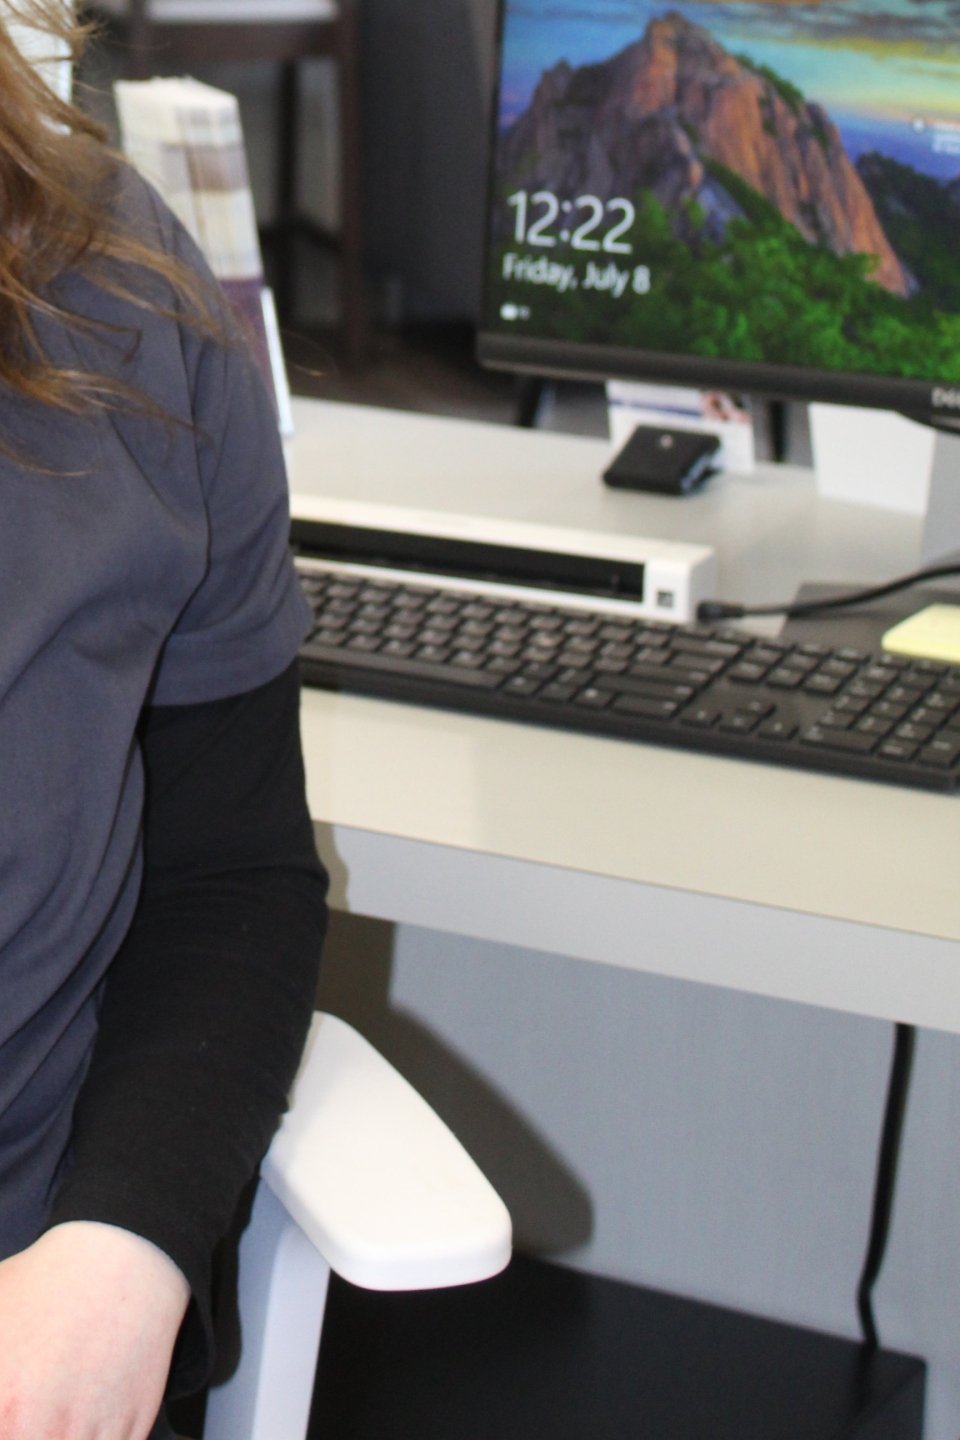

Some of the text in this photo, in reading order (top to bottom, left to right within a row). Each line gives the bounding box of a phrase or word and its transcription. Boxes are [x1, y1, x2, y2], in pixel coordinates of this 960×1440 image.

[507, 189, 636, 254] 12:22
[503, 252, 578, 293] Friday,
[582, 261, 630, 298] July
